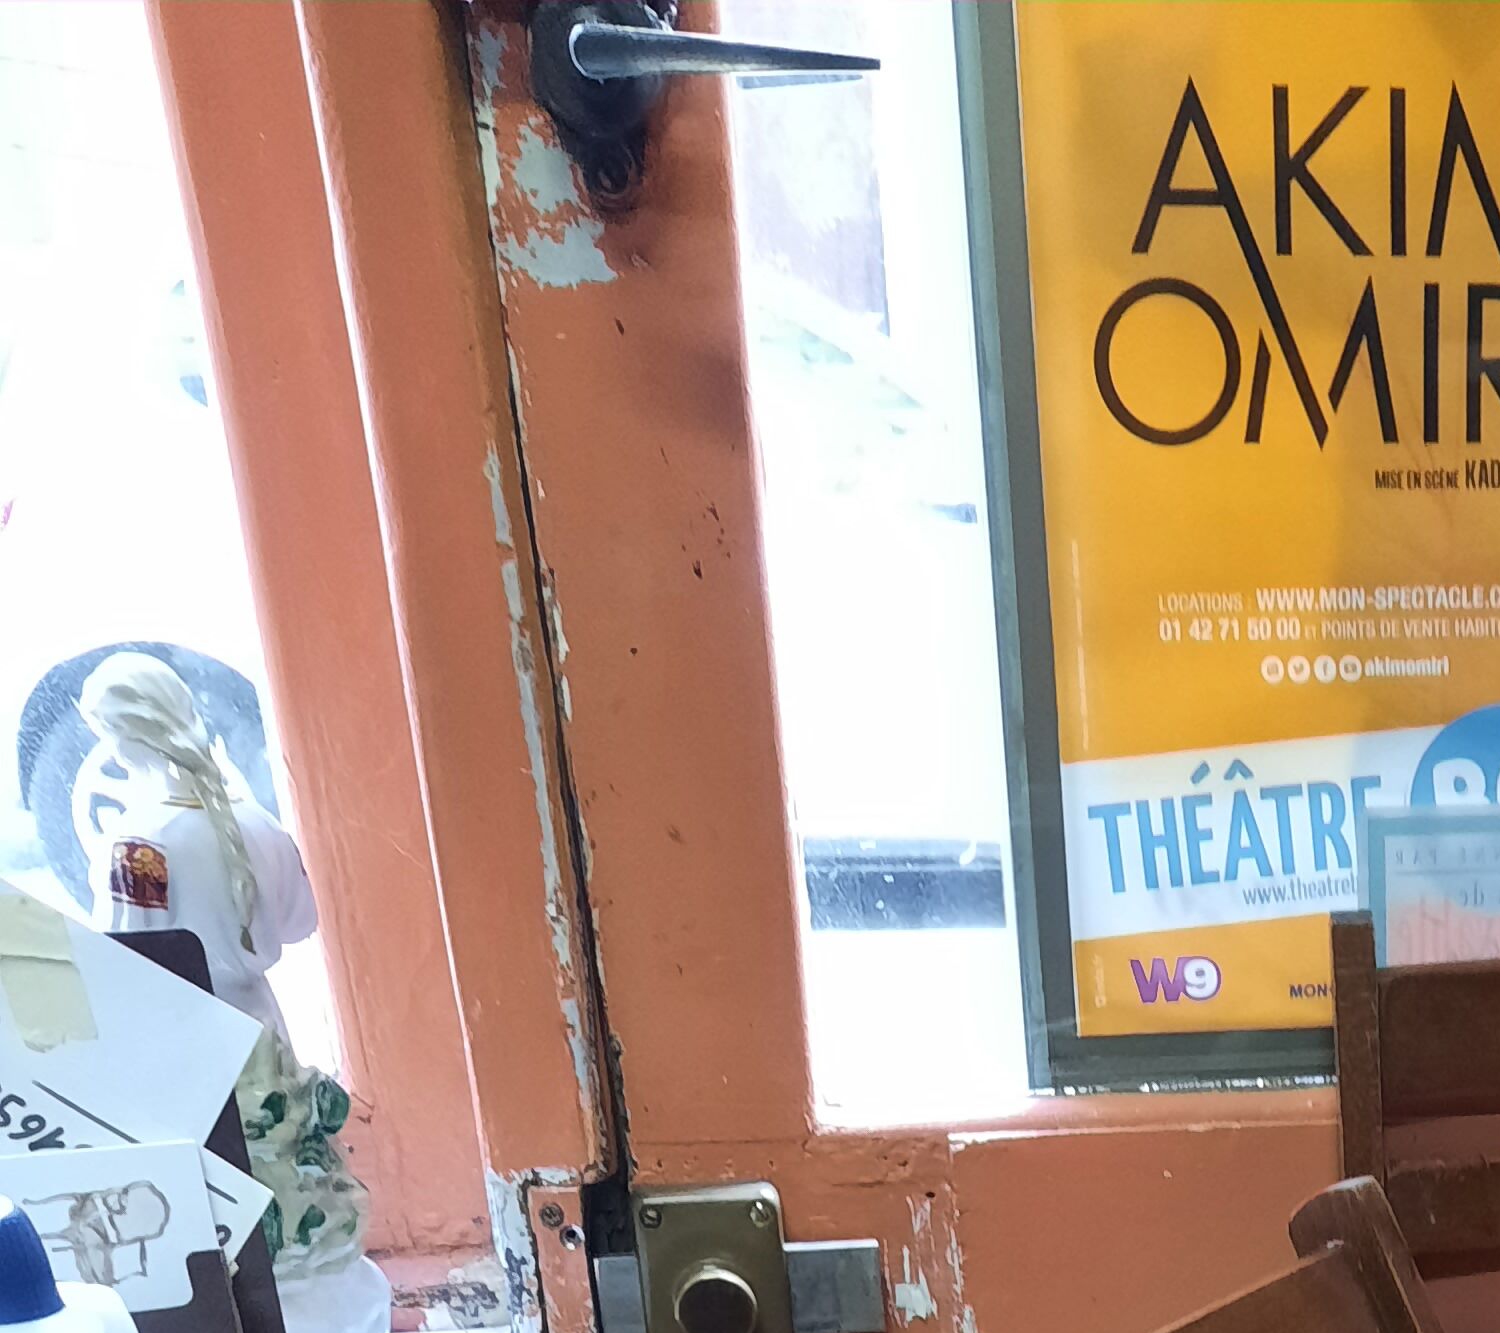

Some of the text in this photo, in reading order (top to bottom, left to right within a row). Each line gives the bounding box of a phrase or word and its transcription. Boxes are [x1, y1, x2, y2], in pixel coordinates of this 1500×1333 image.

[1375, 469, 1404, 489] MISE
[1407, 469, 1422, 489] EN
[1158, 592, 1243, 613] LOCATIONS
[1159, 617, 1181, 641] 01
[1189, 617, 1213, 641] 42
[1218, 617, 1240, 641] 71
[1277, 617, 1300, 641] 00
[1321, 619, 1376, 640] POINTS
[1380, 619, 1400, 639] DE
[1403, 618, 1450, 639] VENTE
[1365, 655, 1450, 677] akimomiri
[1129, 955, 1222, 1004] W9
